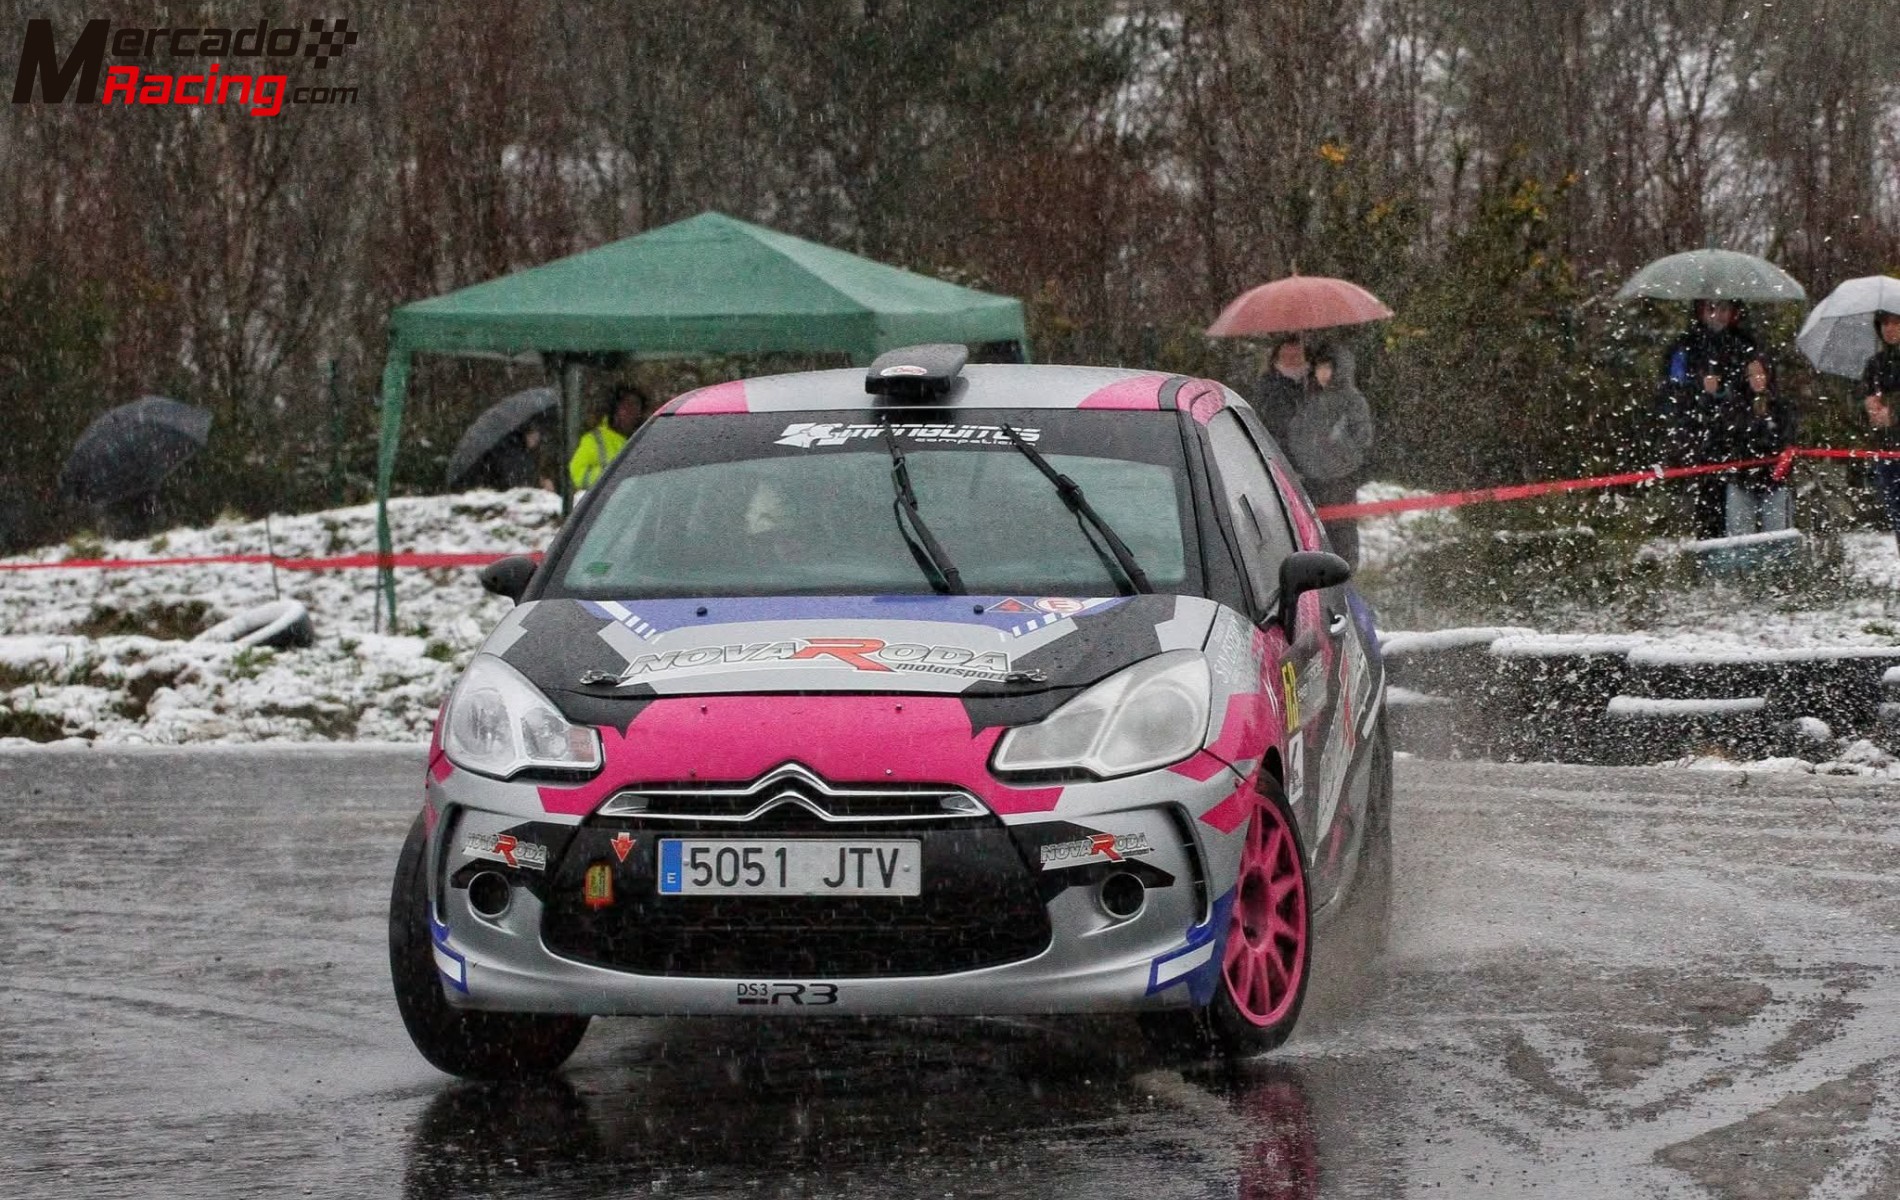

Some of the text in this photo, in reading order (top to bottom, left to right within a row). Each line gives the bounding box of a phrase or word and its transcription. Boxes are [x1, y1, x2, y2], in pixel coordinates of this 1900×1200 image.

[622, 637, 1010, 673] NOVARODA
[1041, 832, 1149, 863] NOVARODA
[667, 872, 676, 884] E
[689, 847, 900, 888] 5051 JTV
[736, 983, 839, 1005] DS3 R3
